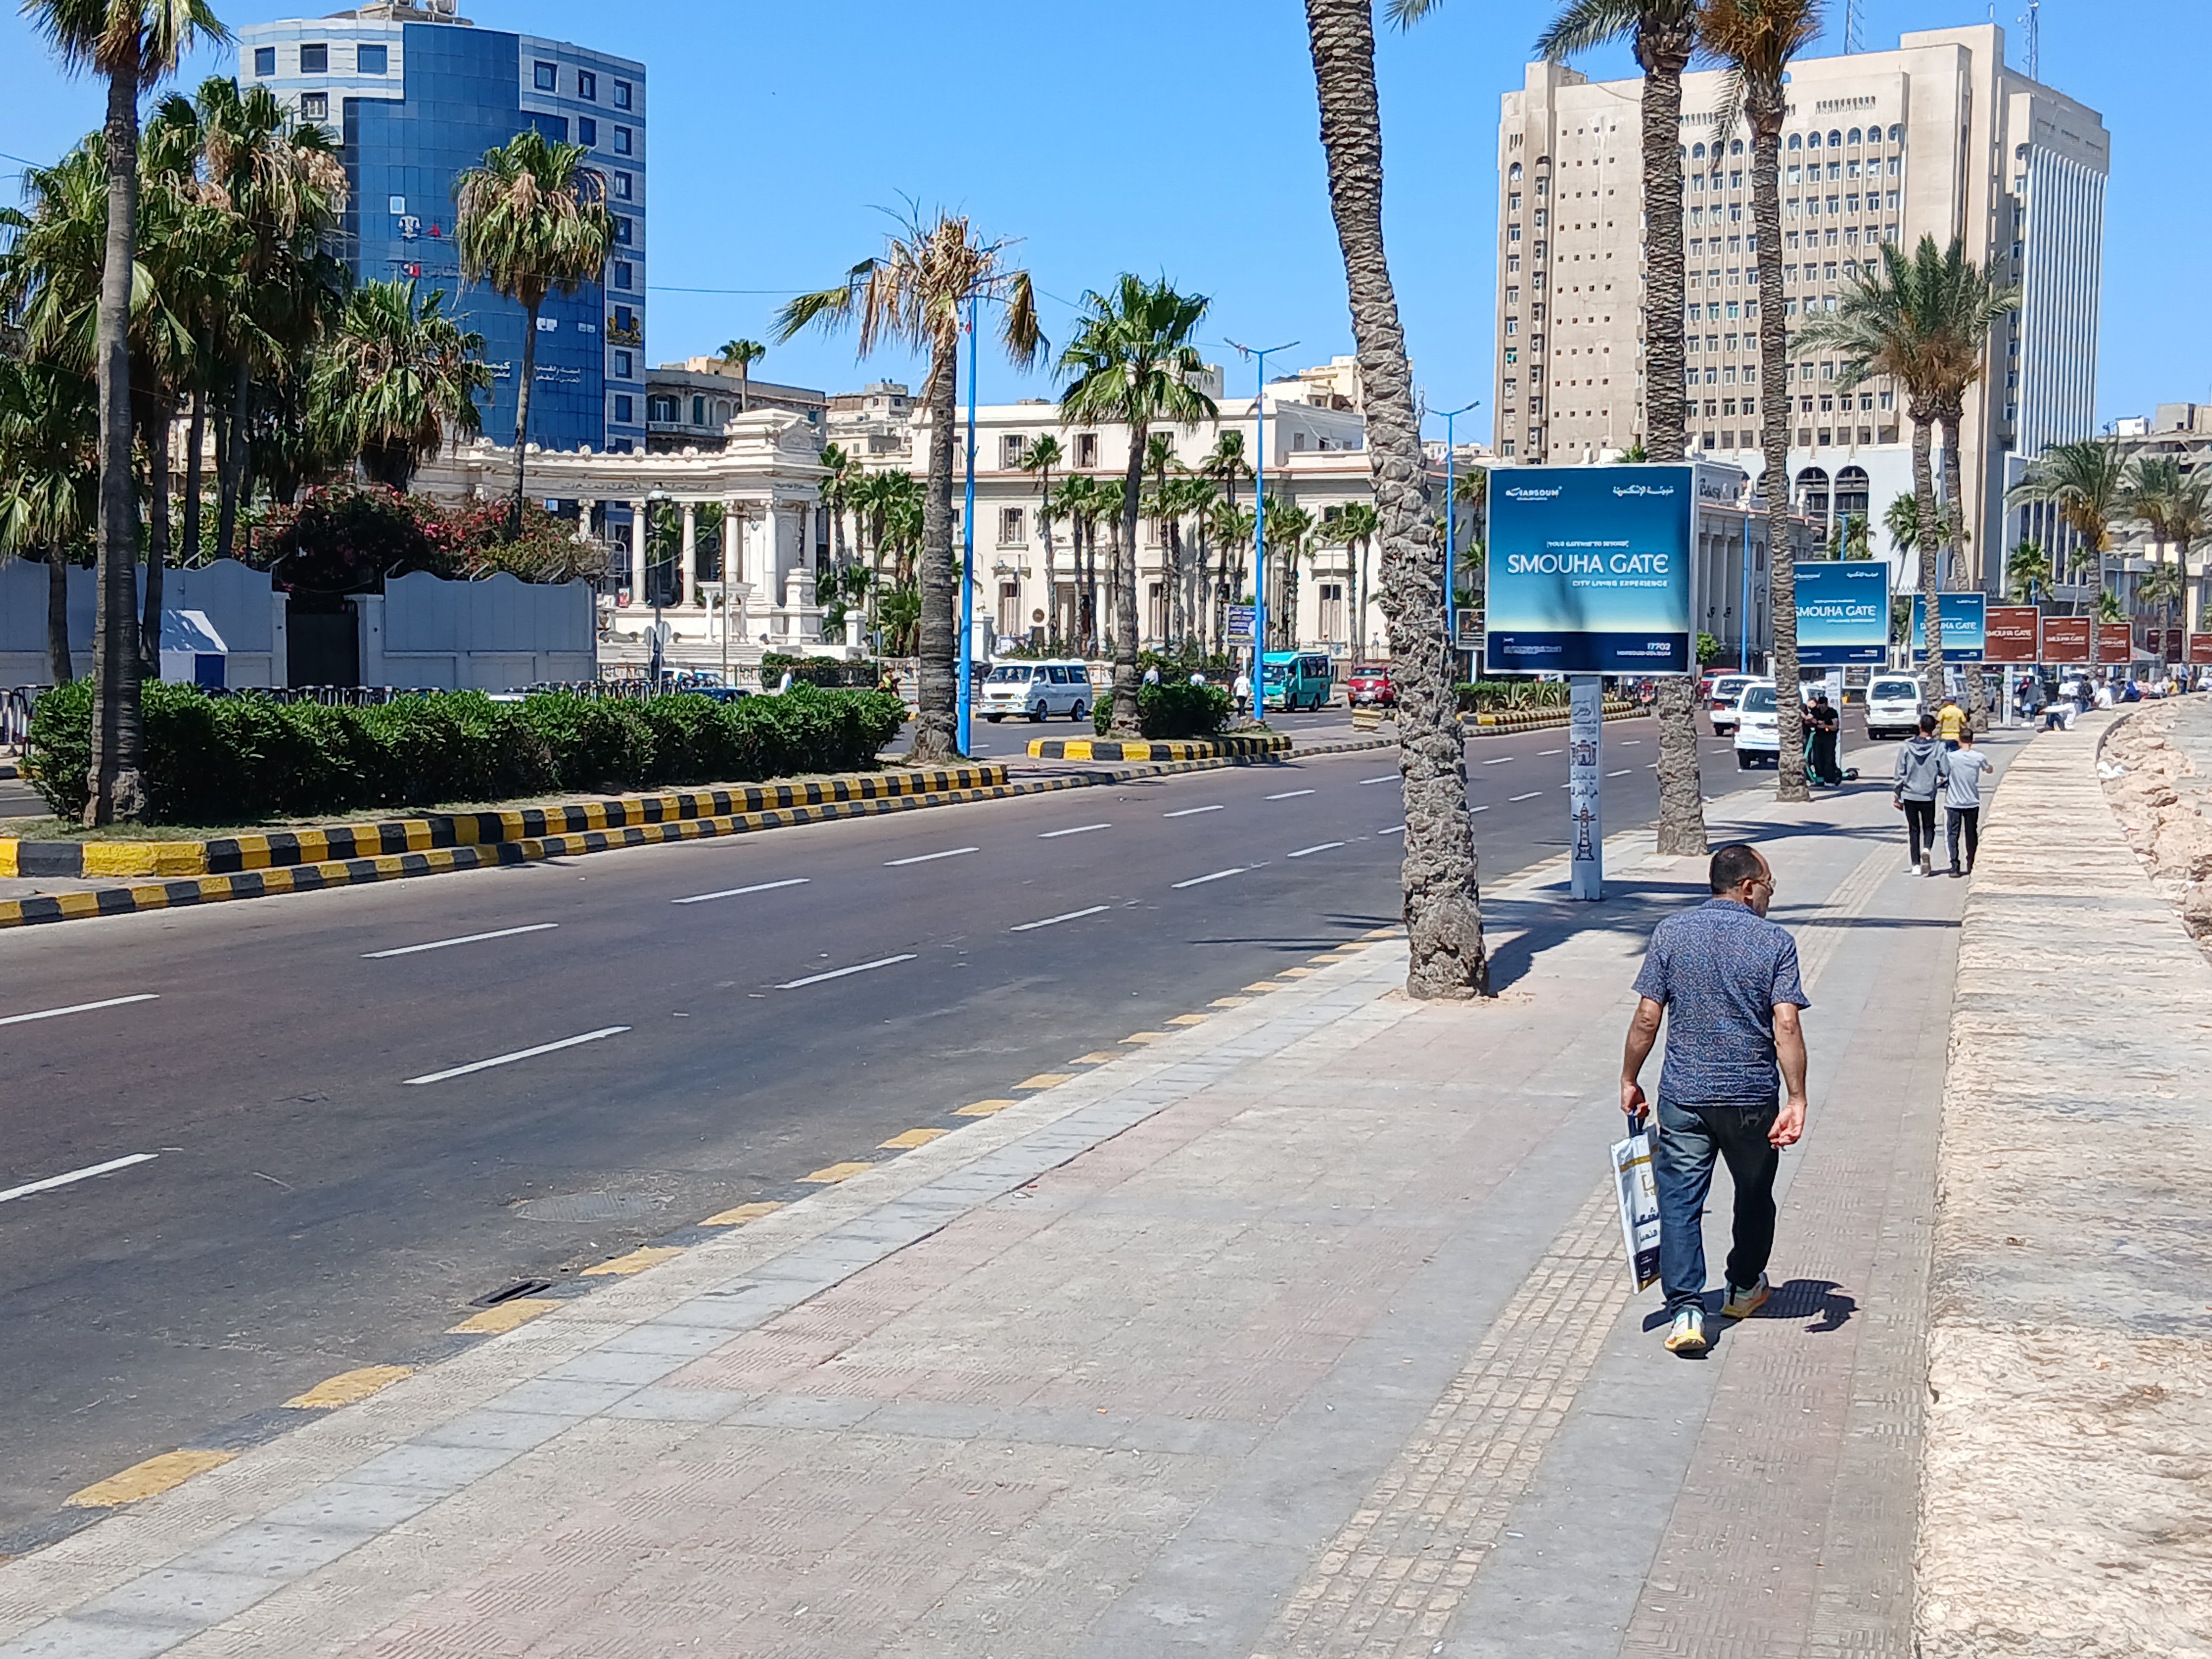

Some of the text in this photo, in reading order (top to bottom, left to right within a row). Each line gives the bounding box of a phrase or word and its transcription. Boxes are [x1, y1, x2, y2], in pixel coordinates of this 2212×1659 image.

[1508, 554, 1669, 574] SMOUHA GATE
[1846, 605, 1877, 616] GATE
